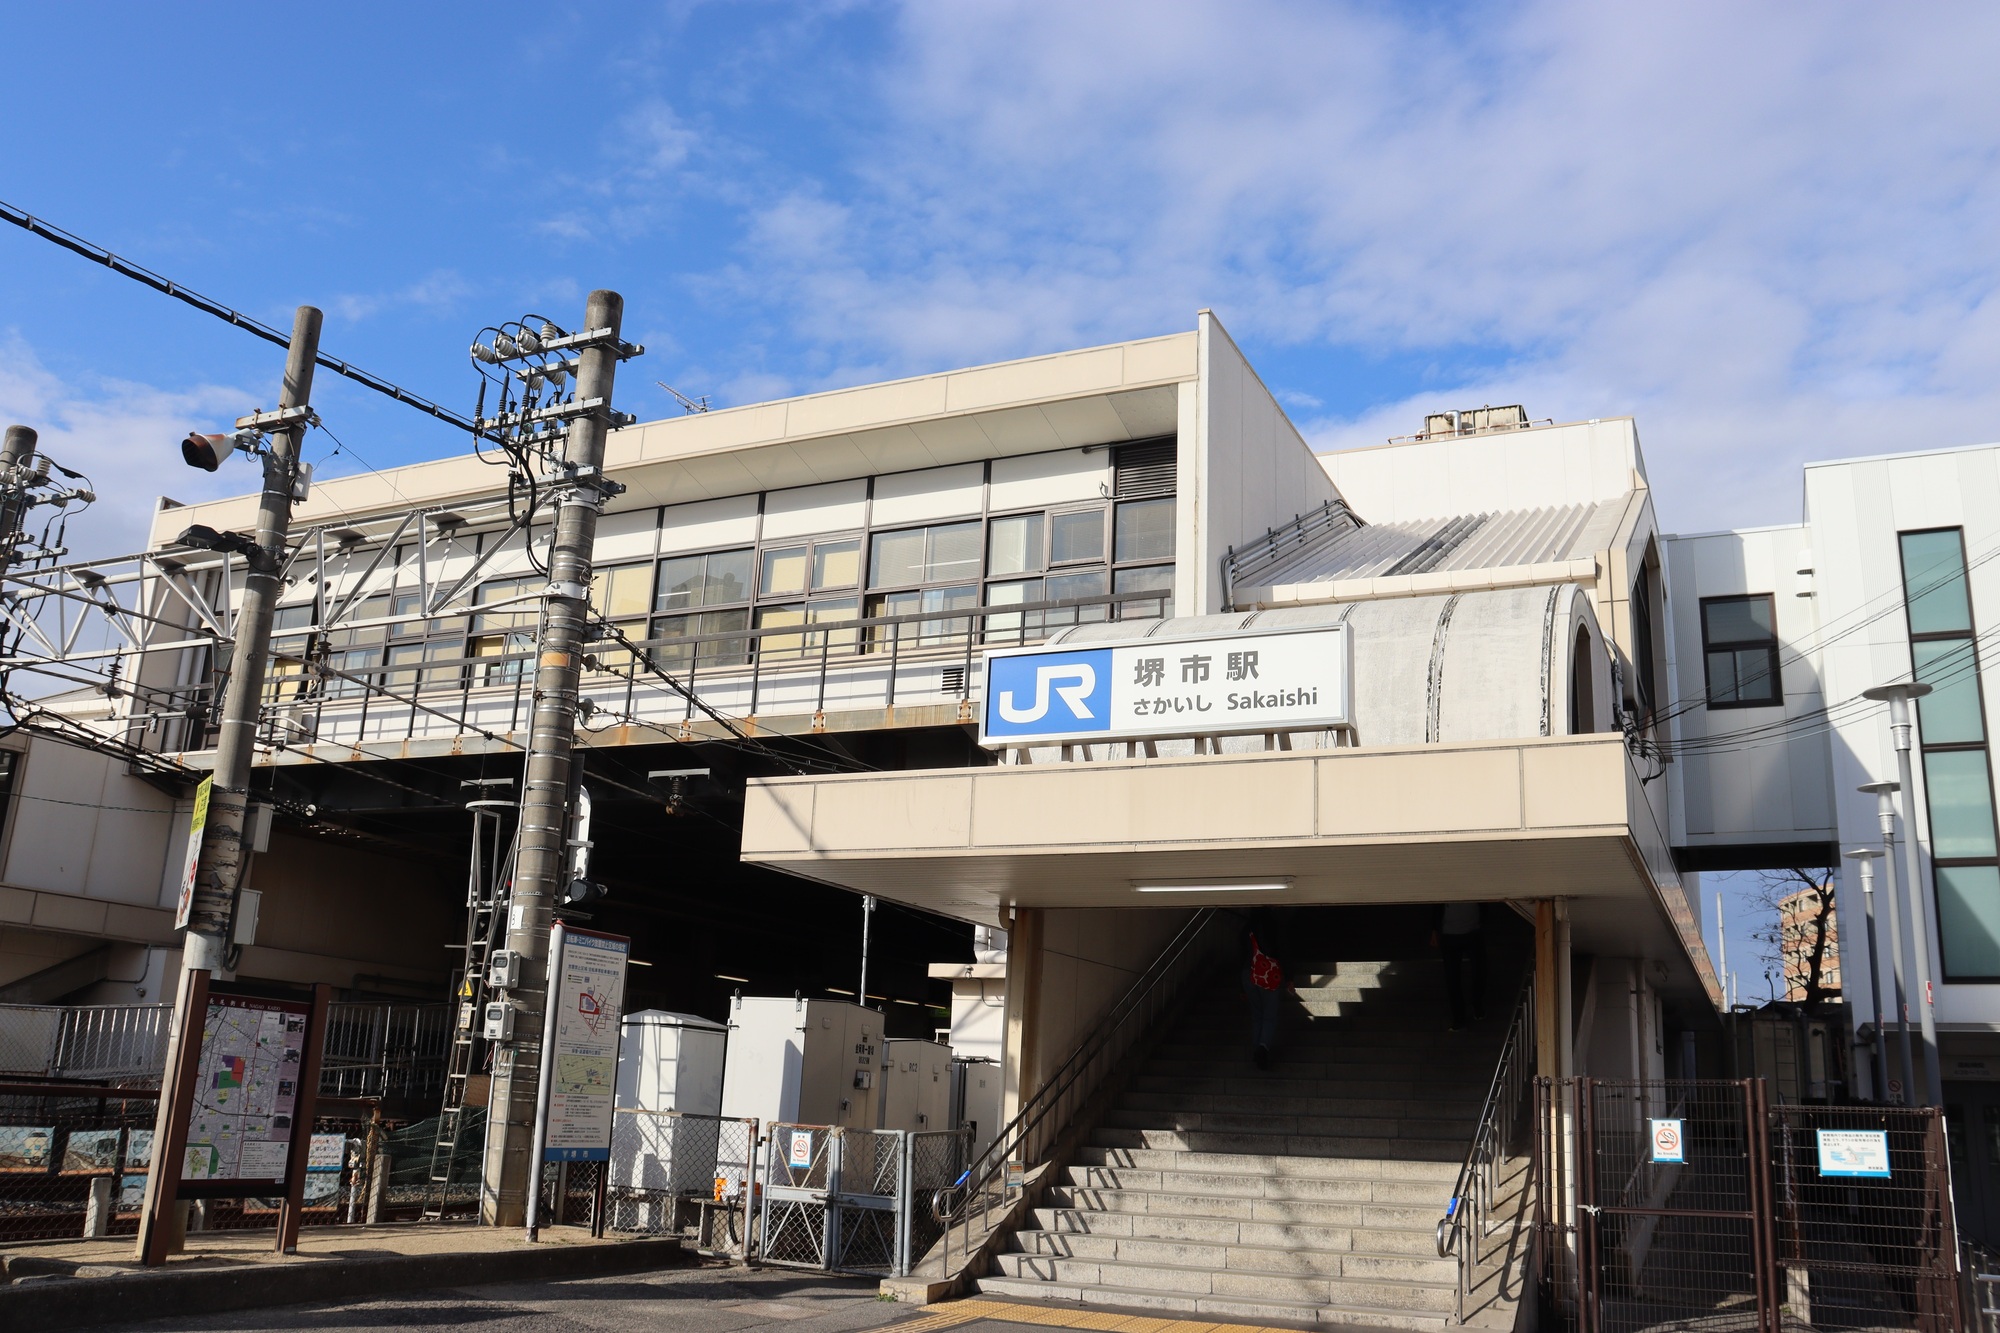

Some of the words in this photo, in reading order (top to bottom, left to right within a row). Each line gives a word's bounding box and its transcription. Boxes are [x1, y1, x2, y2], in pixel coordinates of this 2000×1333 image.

[1133, 650, 1259, 688] 堺市駅
[998, 663, 1096, 724] JR
[1133, 693, 1213, 716] さかいし
[1226, 687, 1318, 710] Sakaishi
